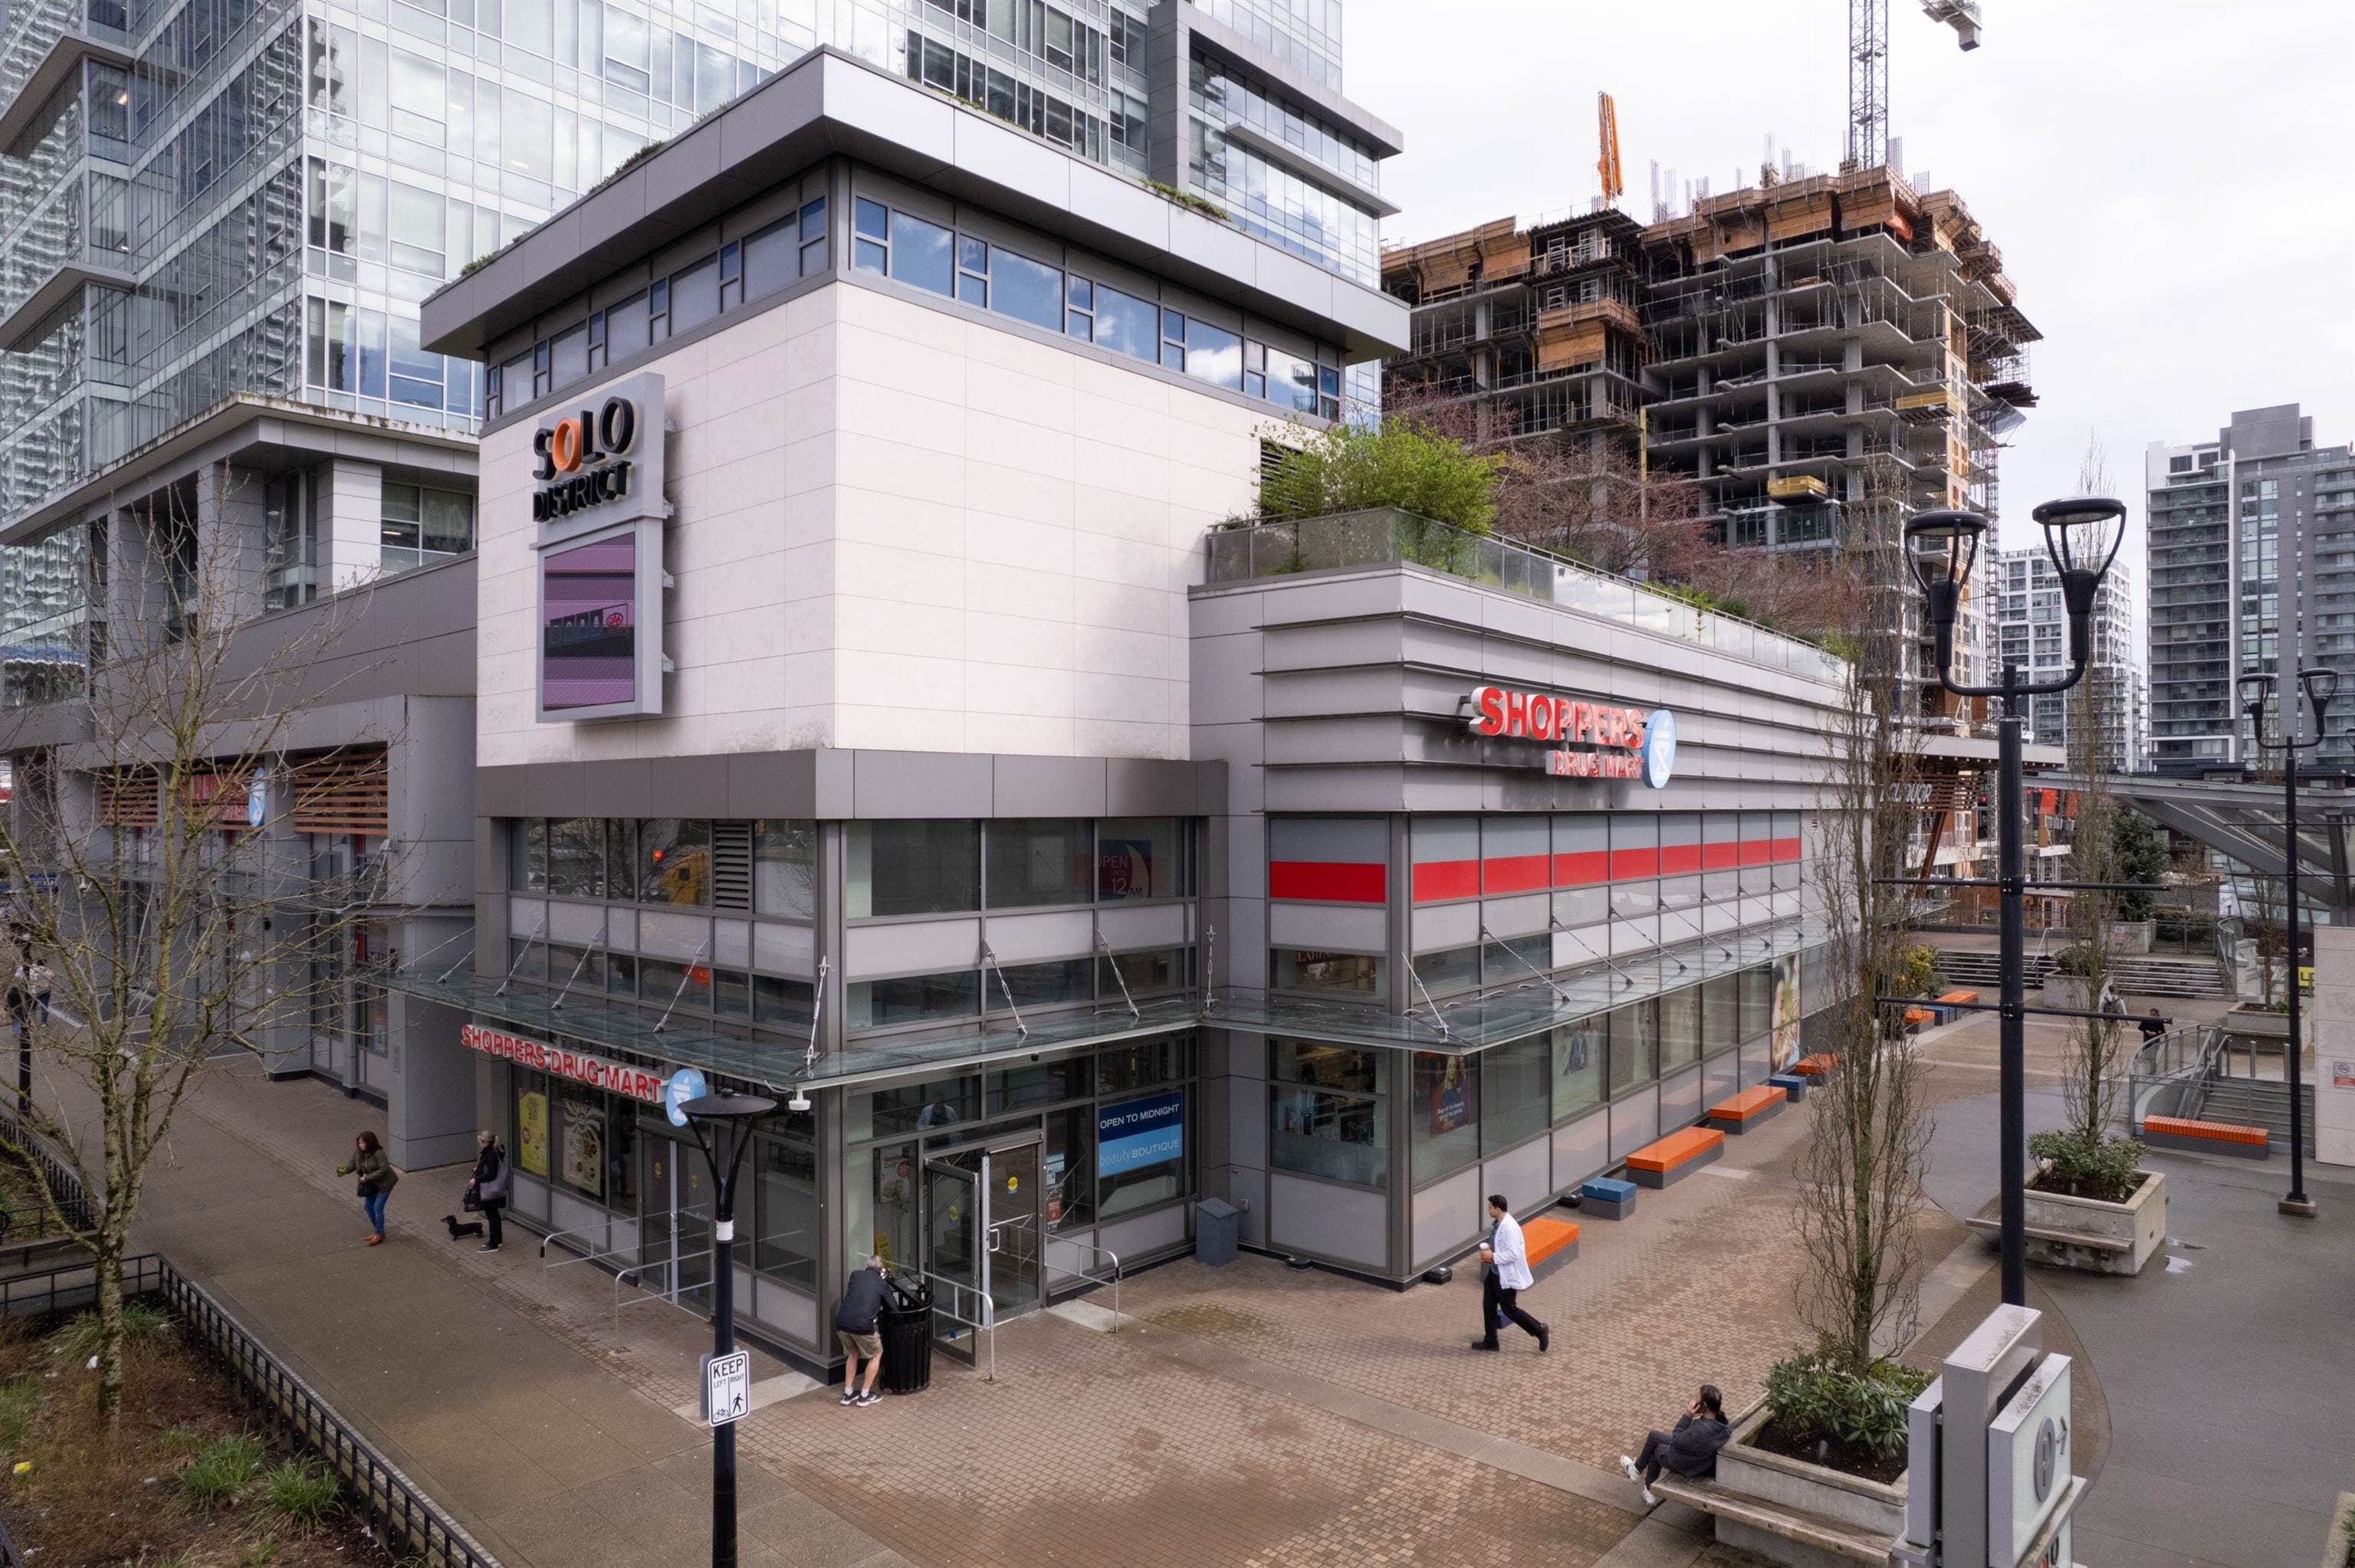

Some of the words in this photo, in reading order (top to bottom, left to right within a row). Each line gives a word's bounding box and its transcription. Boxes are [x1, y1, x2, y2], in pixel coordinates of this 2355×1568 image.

[533, 396, 635, 481] SOLO
[533, 460, 632, 523] DISTRICT
[1470, 687, 1644, 750] SHOPPERS
[1547, 750, 1600, 778] DRUG
[1603, 754, 1644, 779] MART
[1111, 877, 1127, 894] 12
[1129, 887, 1142, 896] AM
[461, 1025, 547, 1070] SHOPPERS
[550, 1048, 599, 1086] DRUG
[603, 1064, 662, 1104] MART
[1099, 1116, 1125, 1129] OPEN
[1126, 1114, 1138, 1123] TO
[1140, 1104, 1180, 1120] MIDNIGHT
[713, 1358, 744, 1379] KEEP
[714, 1379, 726, 1389] LEFT
[730, 1373, 744, 1384] RIGHT
